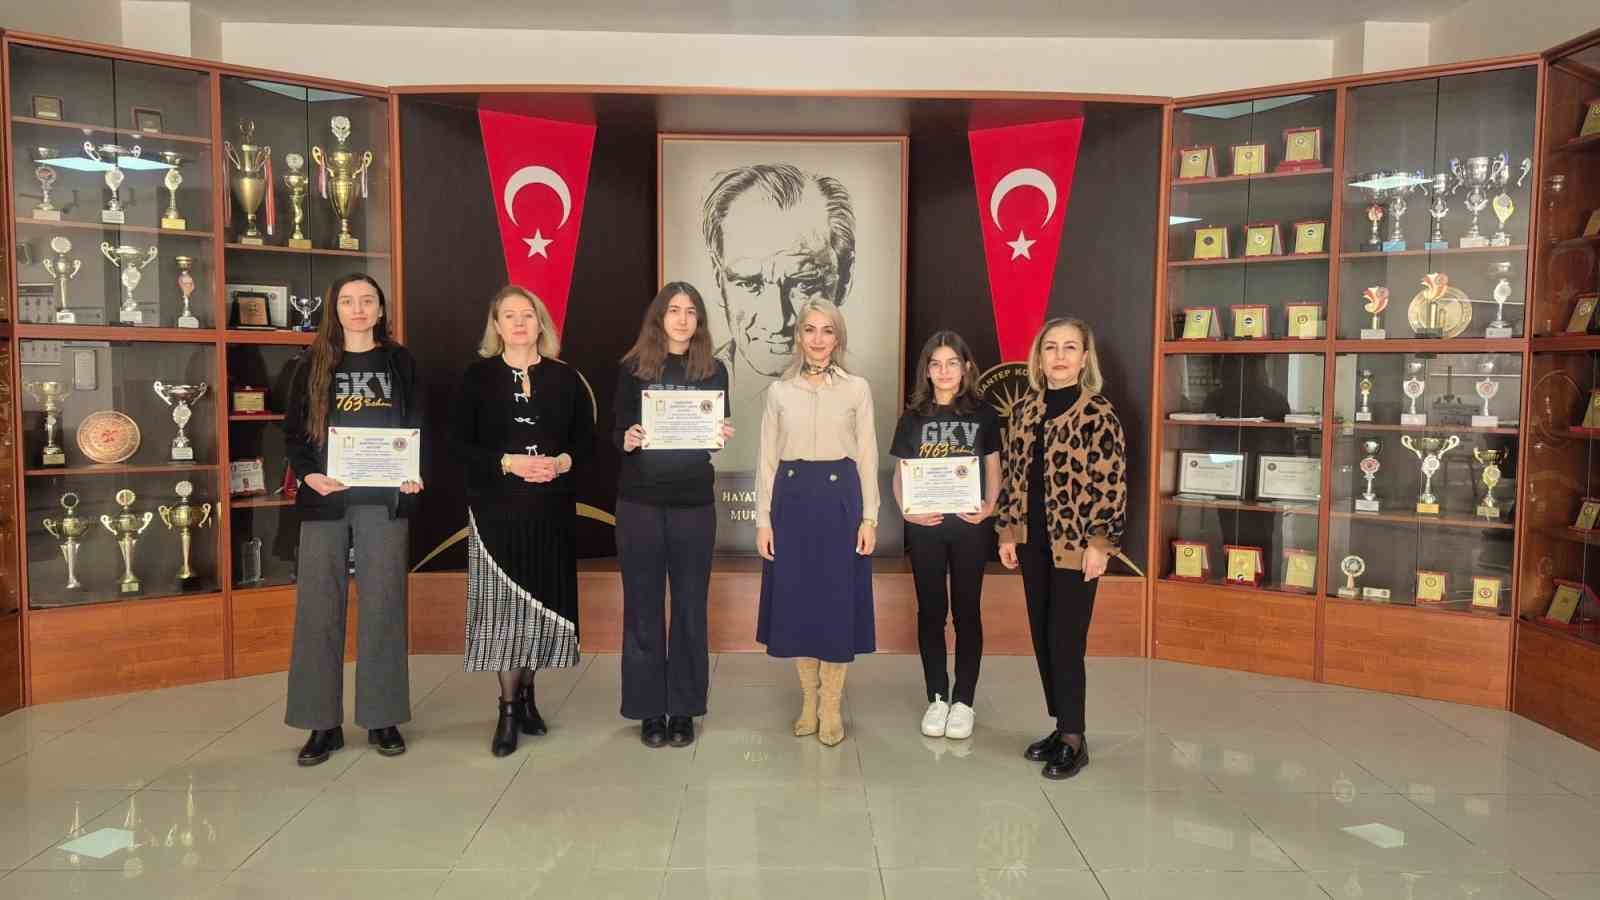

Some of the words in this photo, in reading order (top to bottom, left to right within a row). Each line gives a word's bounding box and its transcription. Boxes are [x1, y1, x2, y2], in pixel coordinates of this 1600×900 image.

[921, 421, 980, 447] GKV
[919, 441, 950, 457] 1963
[722, 491, 757, 502] HAYAT
[730, 509, 758, 521] MUR
